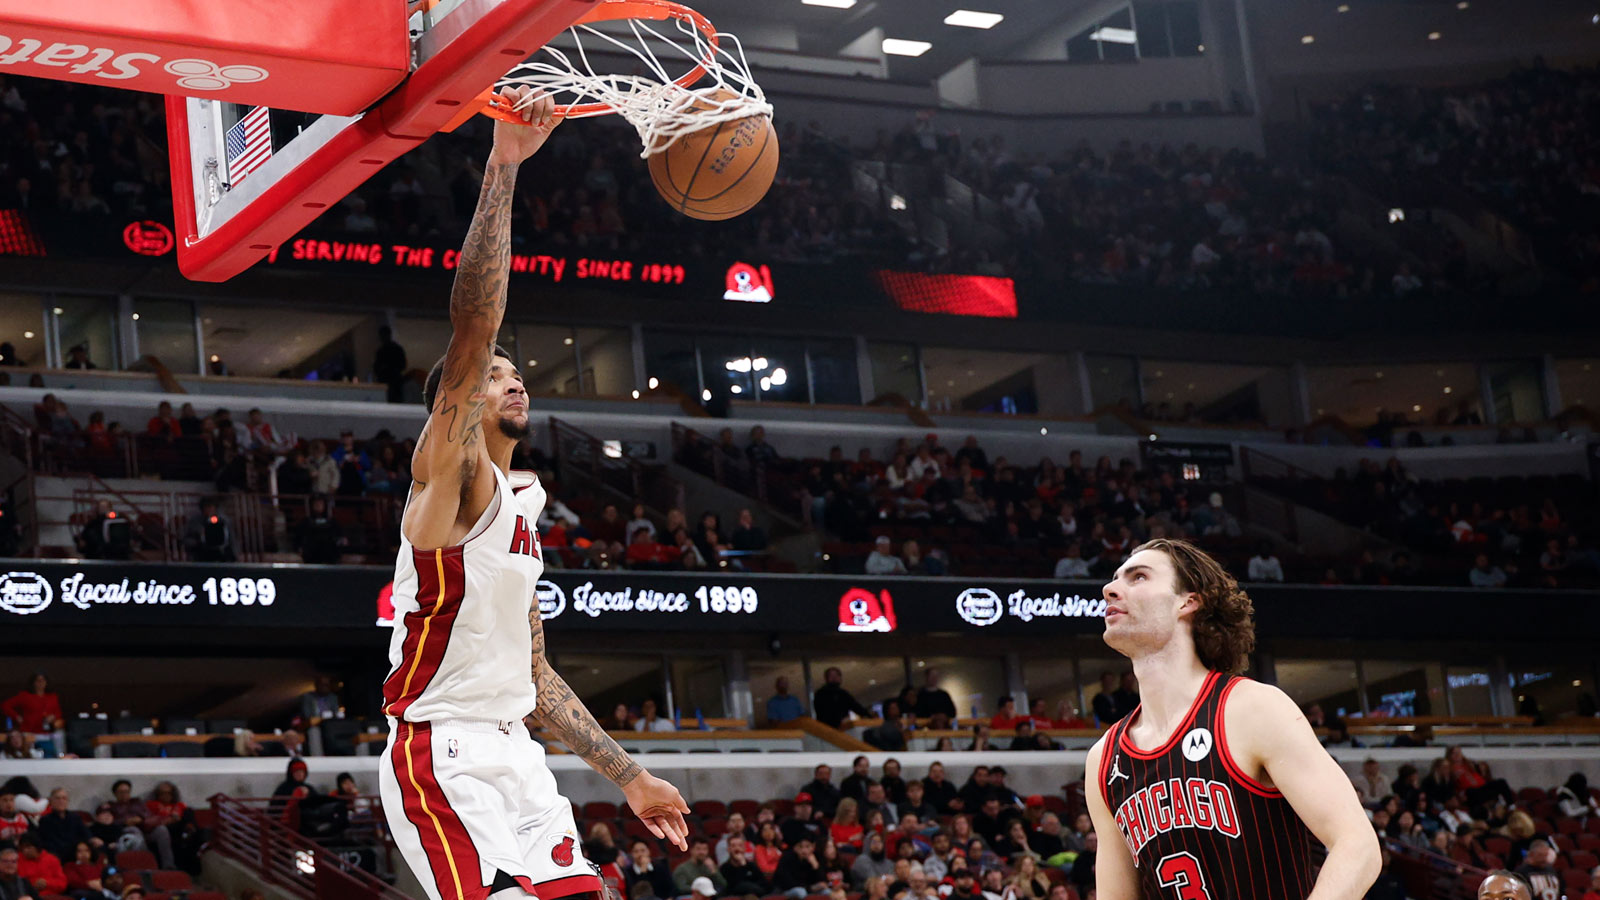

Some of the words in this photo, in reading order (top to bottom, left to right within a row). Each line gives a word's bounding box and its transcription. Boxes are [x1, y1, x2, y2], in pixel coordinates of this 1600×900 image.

[292, 238, 383, 265] SERVING
[392, 244, 435, 269] THE
[576, 257, 633, 281] SINCE
[640, 263, 686, 285] 1899
[60, 572, 132, 610] Local
[132, 579, 197, 605] since
[202, 577, 277, 606] 1899
[572, 581, 634, 618] Local
[634, 588, 691, 613] since
[694, 585, 758, 614] 1899
[1008, 588, 1062, 623] Local
